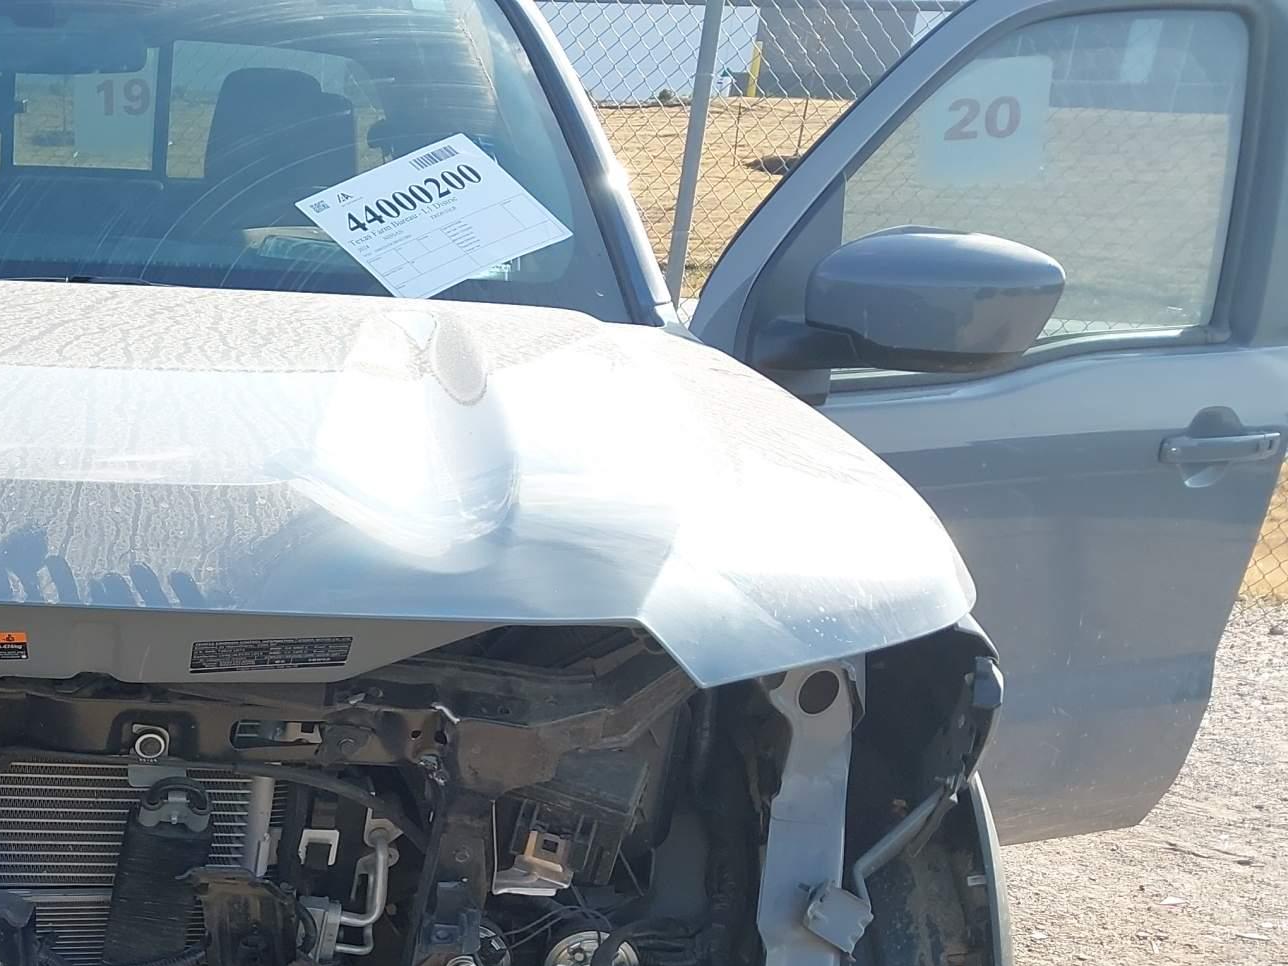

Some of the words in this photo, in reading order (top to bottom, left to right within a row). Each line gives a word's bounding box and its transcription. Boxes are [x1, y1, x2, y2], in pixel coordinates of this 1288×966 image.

[96, 78, 151, 116] 19
[943, 95, 1022, 141] 20
[347, 164, 482, 231] 44000200
[371, 225, 392, 238] Farm
